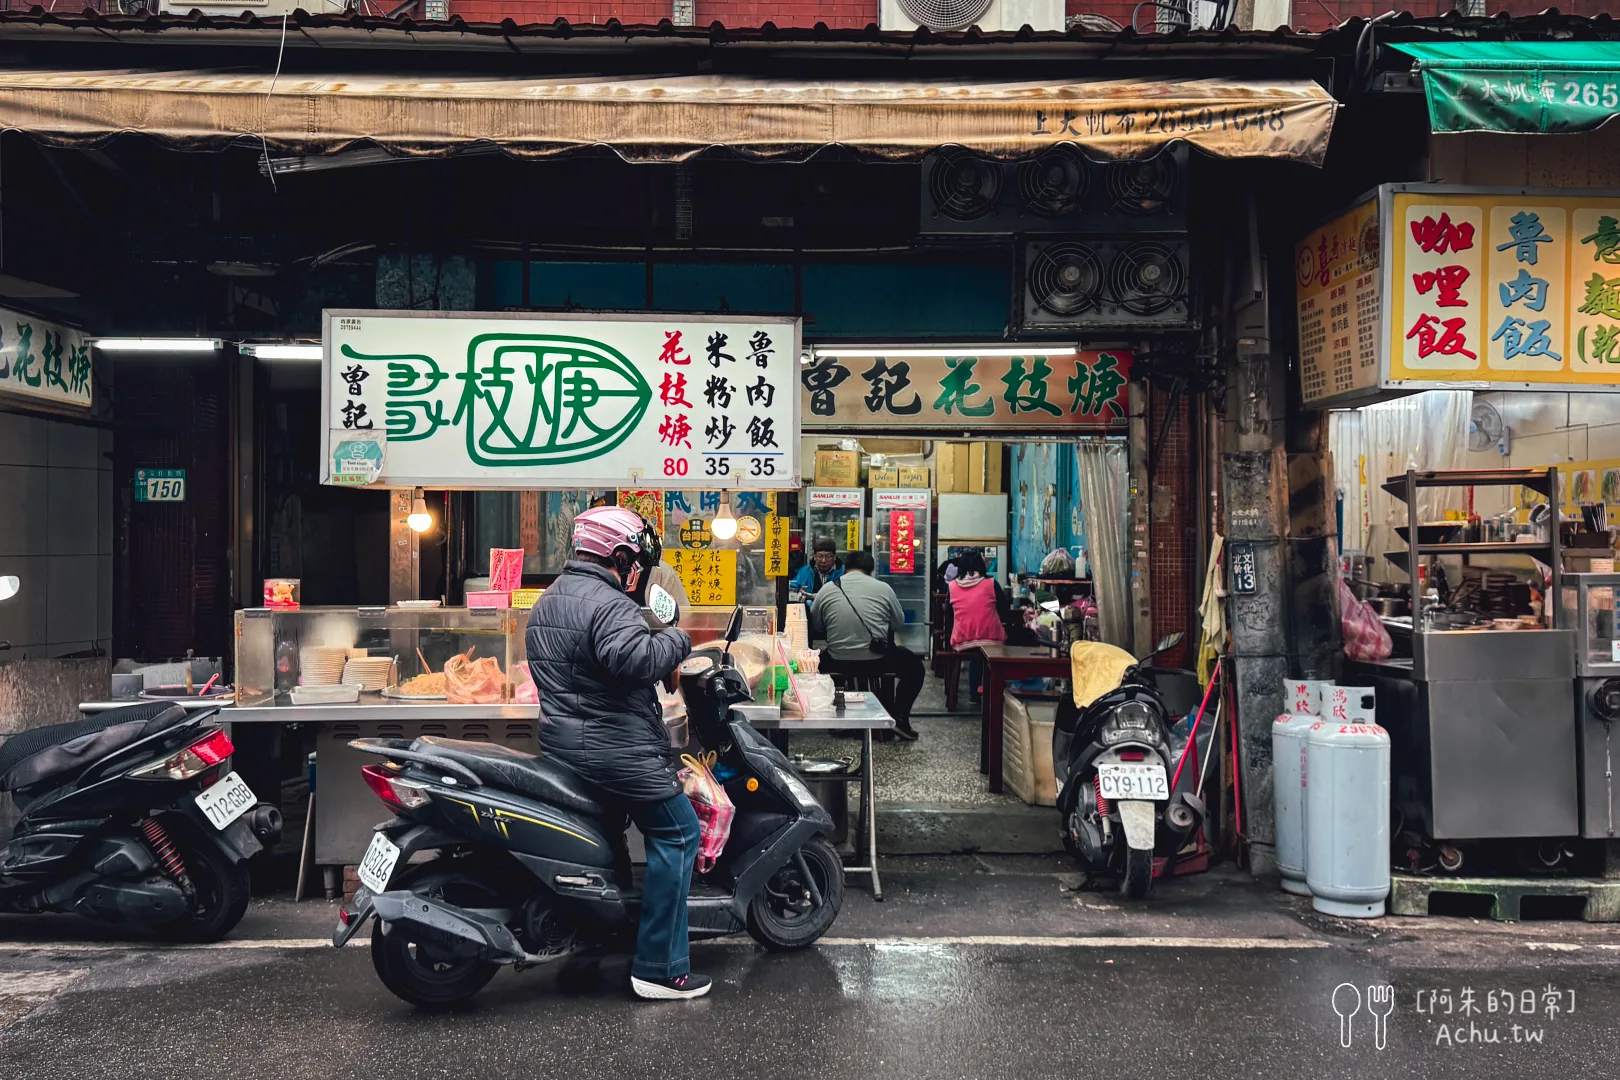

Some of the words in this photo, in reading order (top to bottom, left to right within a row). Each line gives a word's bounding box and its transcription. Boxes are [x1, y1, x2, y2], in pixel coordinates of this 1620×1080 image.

[1031, 108, 1138, 137] 上大帆布
[1144, 107, 1286, 135] 26591648
[1406, 212, 1478, 360] 咖哩飯
[1491, 210, 1563, 362] 魯肉飯
[340, 363, 374, 430] 曾記
[704, 331, 737, 450] 米粉炒
[745, 330, 779, 449] 魯肉飯
[662, 458, 690, 477] 80
[705, 458, 730, 477] 35
[750, 458, 775, 477] 35
[151, 480, 182, 498] 150
[708, 592, 723, 602] 80
